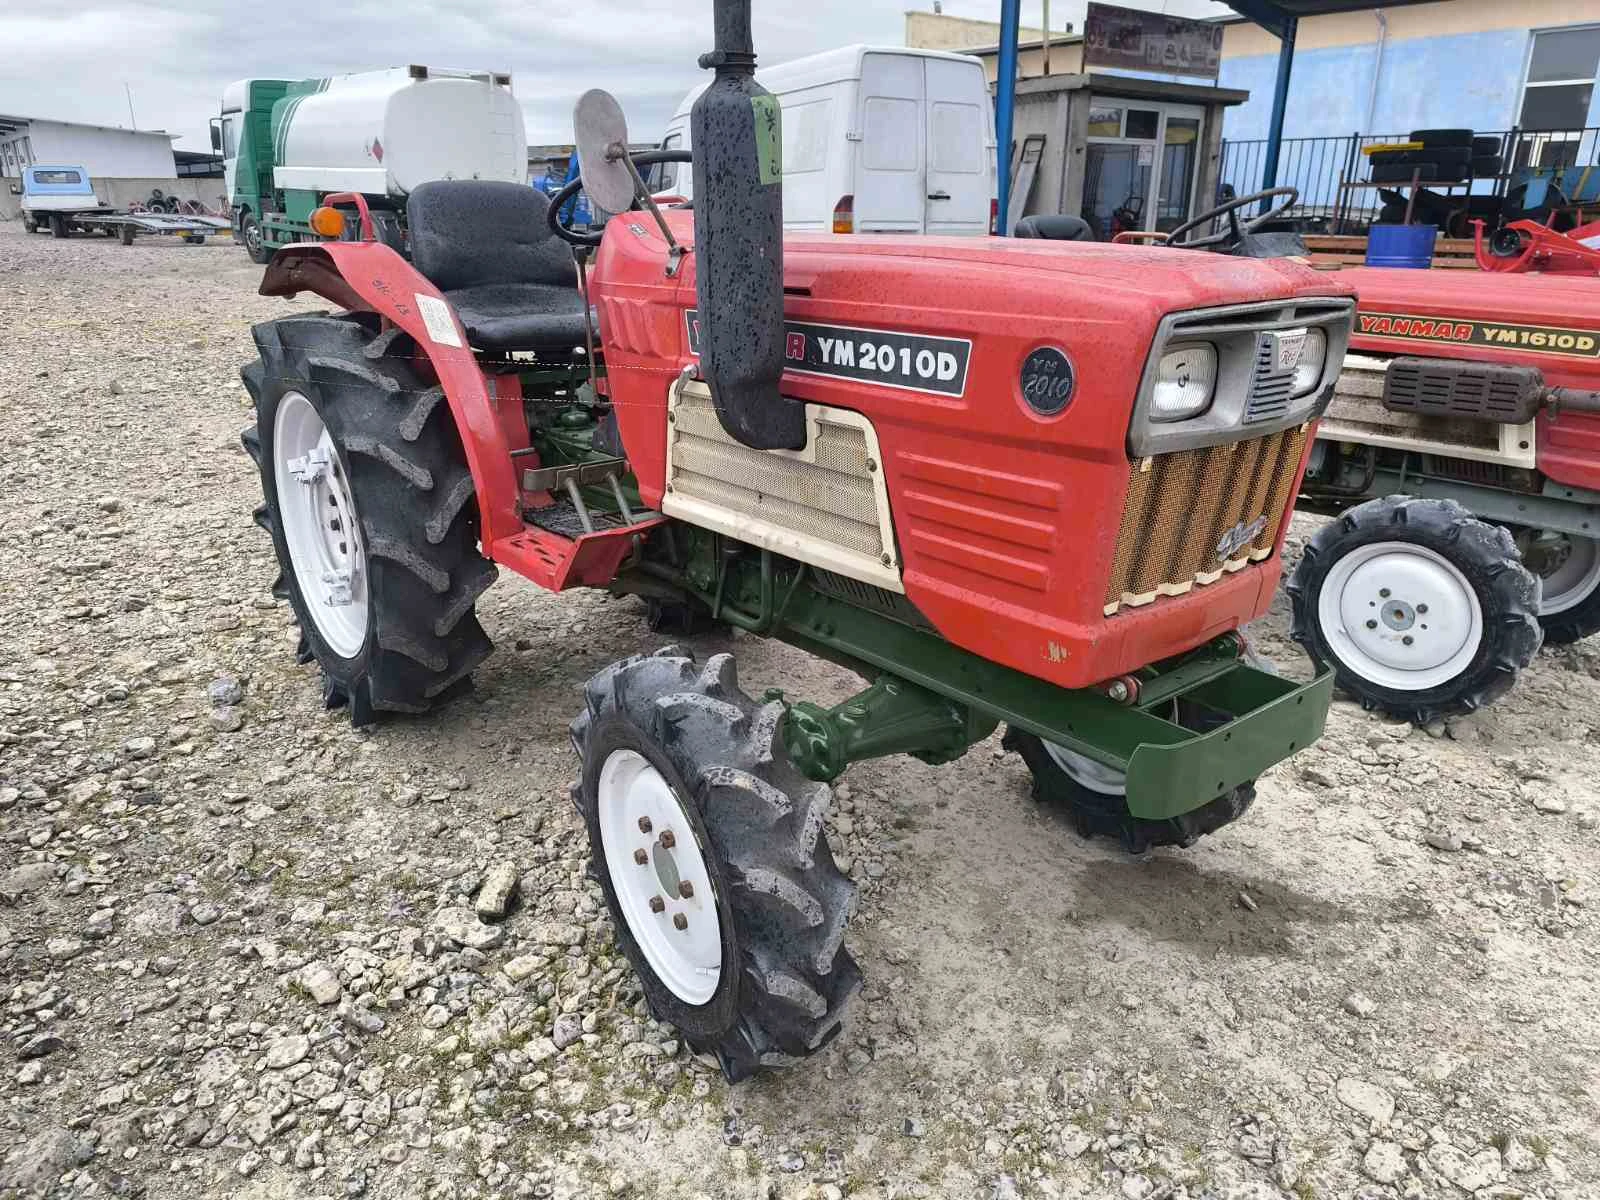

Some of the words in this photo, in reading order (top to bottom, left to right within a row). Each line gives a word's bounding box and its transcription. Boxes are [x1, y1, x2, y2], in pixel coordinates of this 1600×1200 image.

[1360, 316, 1474, 341] YANMAR
[1482, 327, 1595, 351] YM1610D
[817, 336, 958, 382] YM2010D
[1024, 373, 1070, 398] 2010
